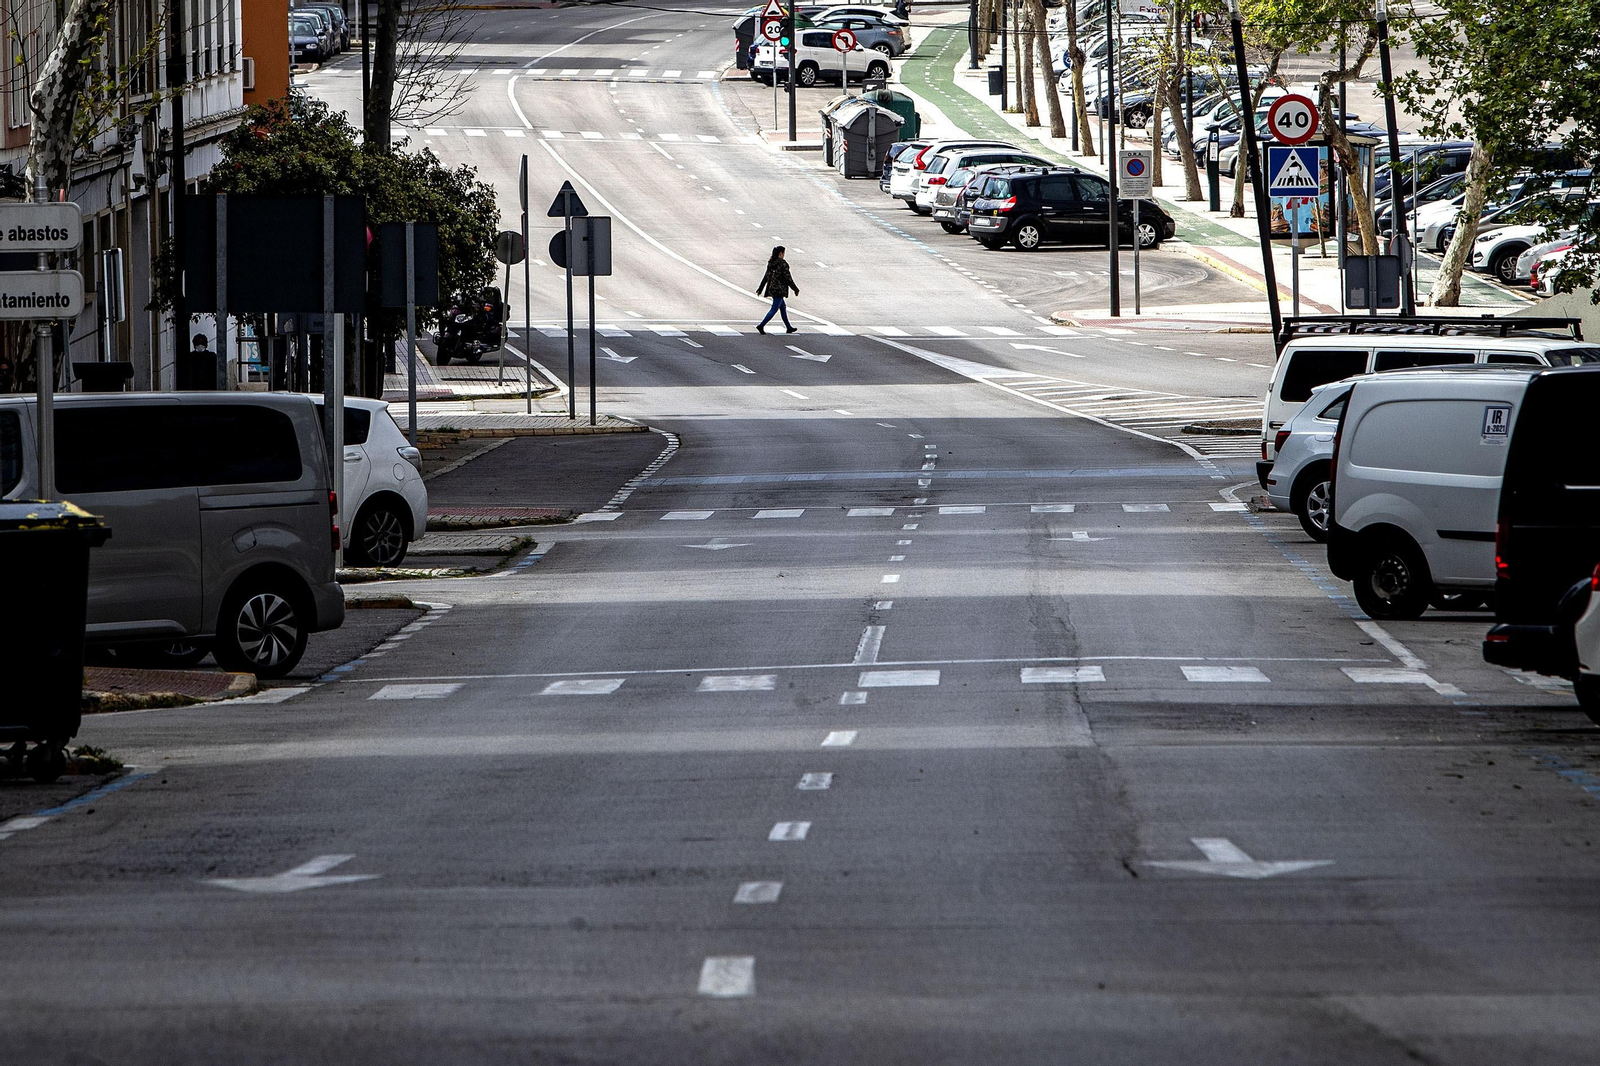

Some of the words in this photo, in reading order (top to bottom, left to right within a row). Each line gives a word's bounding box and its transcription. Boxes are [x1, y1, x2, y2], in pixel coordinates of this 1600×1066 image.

[767, 26, 781, 34] 20
[1278, 112, 1309, 128] 40
[8, 225, 69, 241] abastos
[0, 292, 71, 308] tamiento
[1491, 410, 1503, 424] IR
